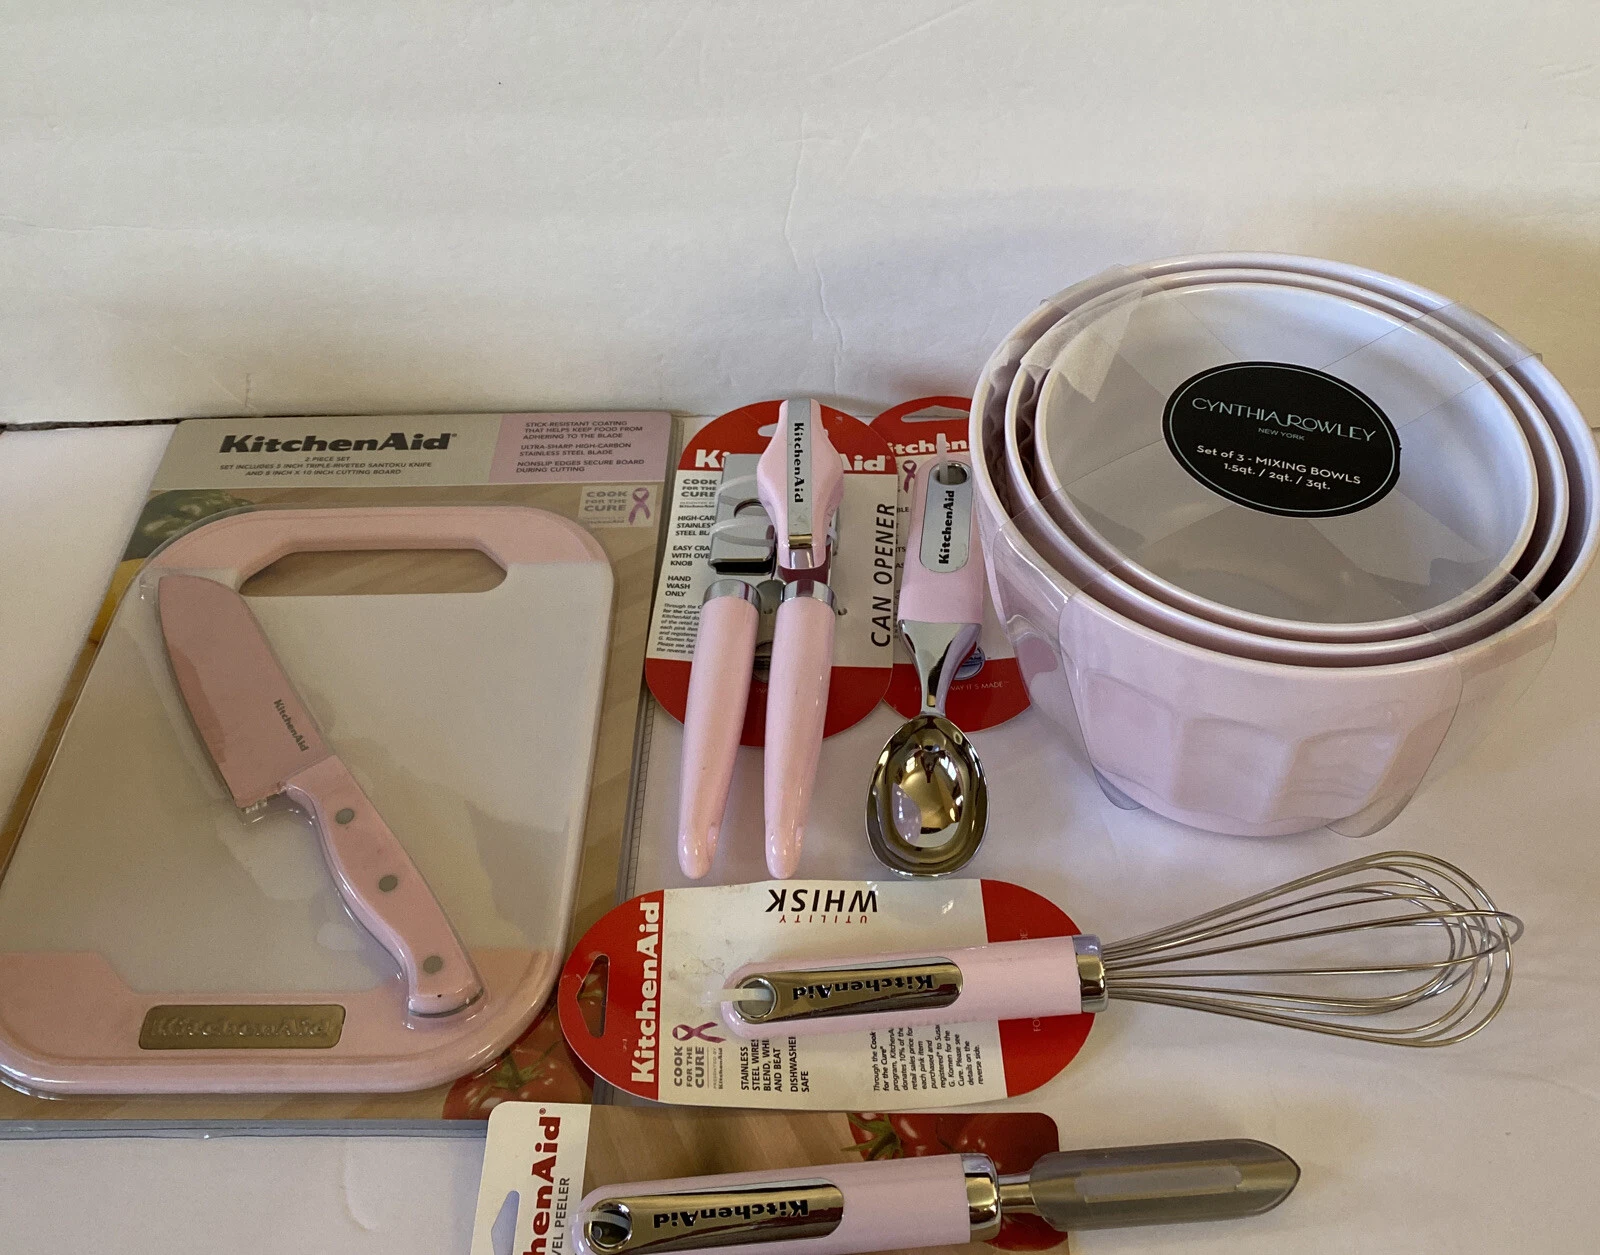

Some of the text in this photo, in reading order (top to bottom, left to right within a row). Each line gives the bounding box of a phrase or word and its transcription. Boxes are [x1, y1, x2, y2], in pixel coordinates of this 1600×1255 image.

[1192, 397, 1376, 442] CYNTHIA ROWLEY
[1258, 428, 1305, 441] NEW YORK
[794, 422, 804, 503] KitchenAid
[1197, 445, 1218, 456] Set
[1220, 450, 1235, 459] of
[1236, 454, 1244, 462] 3
[1256, 456, 1307, 473] MIXING
[1310, 467, 1361, 484] BOWLS
[1224, 462, 1256, 476] 1.5qt.
[1268, 472, 1293, 484] 2qt.
[1306, 479, 1331, 490] 3qt.
[938, 490, 955, 564] KitchenAid
[870, 503, 895, 648] CAN OPENER
[274, 699, 310, 752] KitchenAid
[766, 888, 878, 912] WHISK
[779, 914, 868, 924] UTILITY
[632, 902, 660, 1082] KitchenAid
[793, 975, 934, 1000] KitchenAid
[898, 1038, 904, 1047] of
[674, 1046, 683, 1087] COOK
[695, 1047, 704, 1088] CURE
[740, 1046, 749, 1090] STAINLESS
[773, 1048, 782, 1092] AND BEAT
[919, 1057, 927, 1073] pink
[928, 1054, 938, 1089] purchased
[966, 1054, 971, 1063] on
[752, 1066, 760, 1091] STEEL
[762, 1060, 772, 1091] BLEND,
[801, 1071, 810, 1092] SAFE
[872, 1064, 880, 1091] Through
[892, 1060, 900, 1091] program,
[966, 1064, 974, 1086] details
[554, 1178, 570, 1228] PEELER
[654, 1200, 808, 1228] KitchenAid
